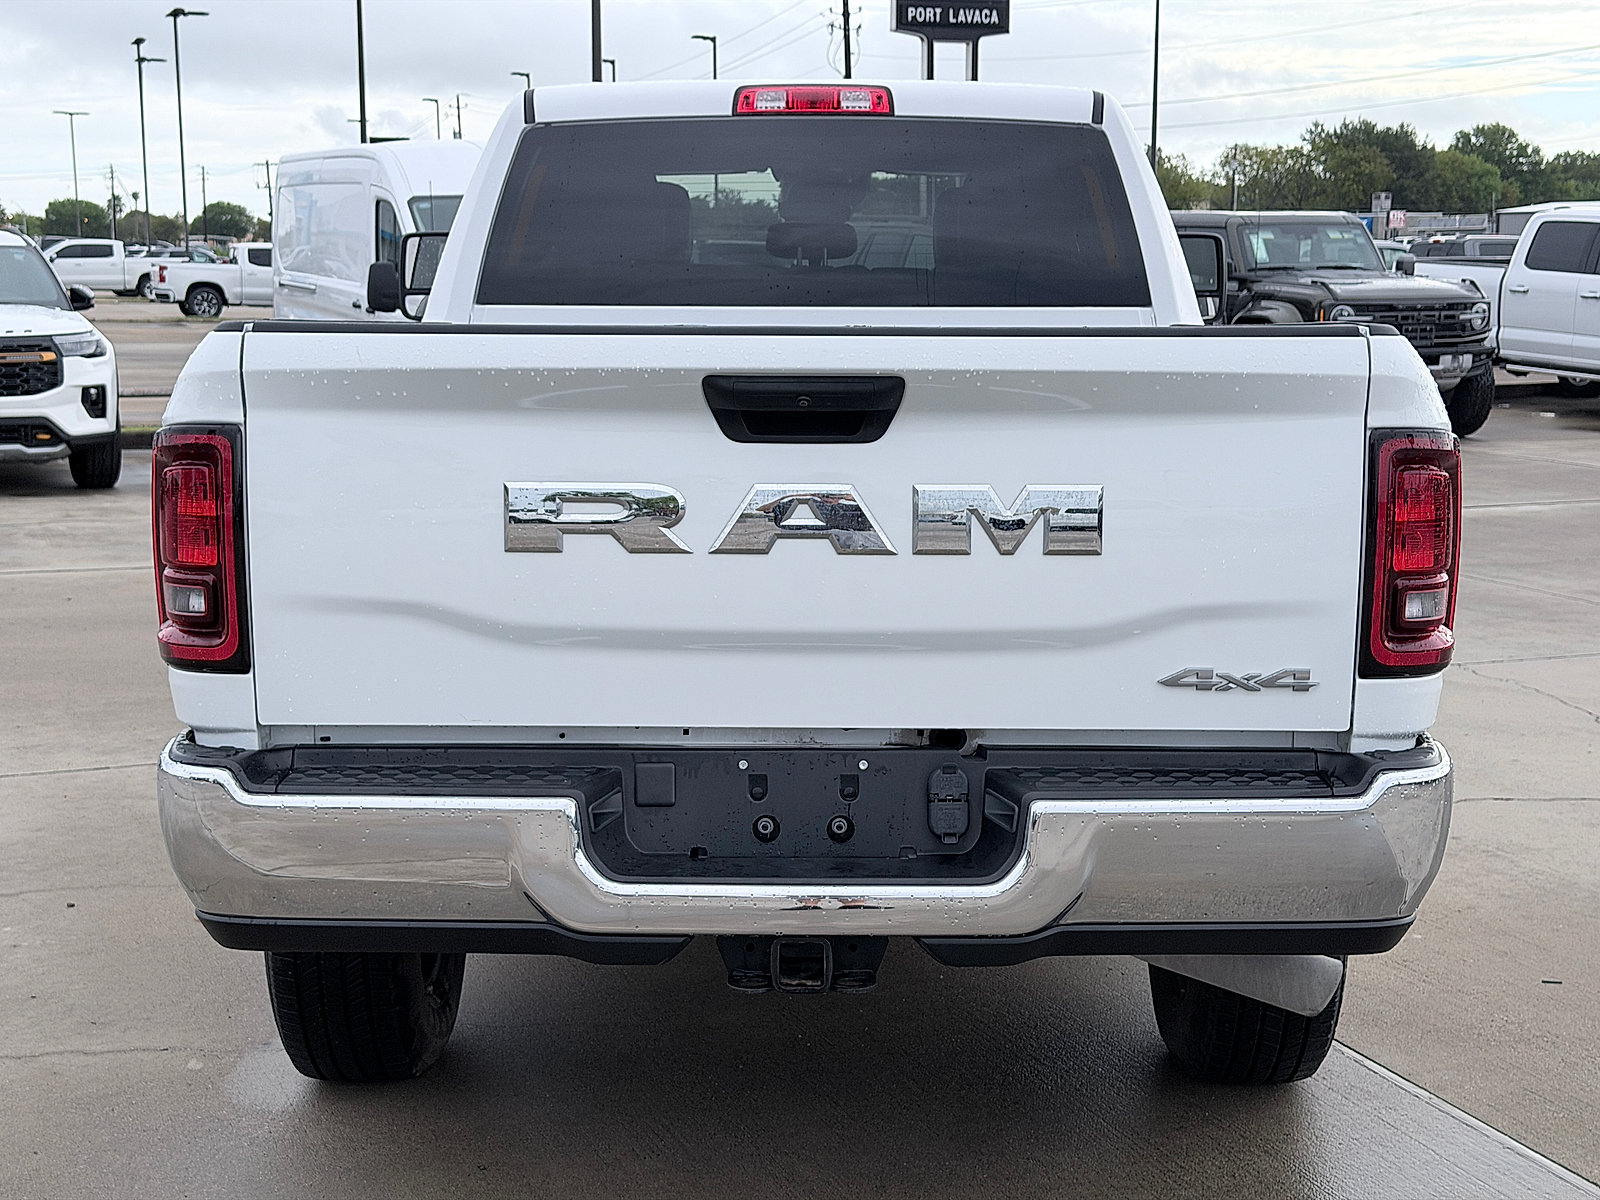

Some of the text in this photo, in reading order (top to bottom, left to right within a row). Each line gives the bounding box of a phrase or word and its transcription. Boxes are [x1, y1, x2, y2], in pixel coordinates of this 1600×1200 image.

[907, 7, 1000, 25] PORT LAVACA
[503, 481, 1105, 556] RAM
[1157, 666, 1320, 692] 4x4
